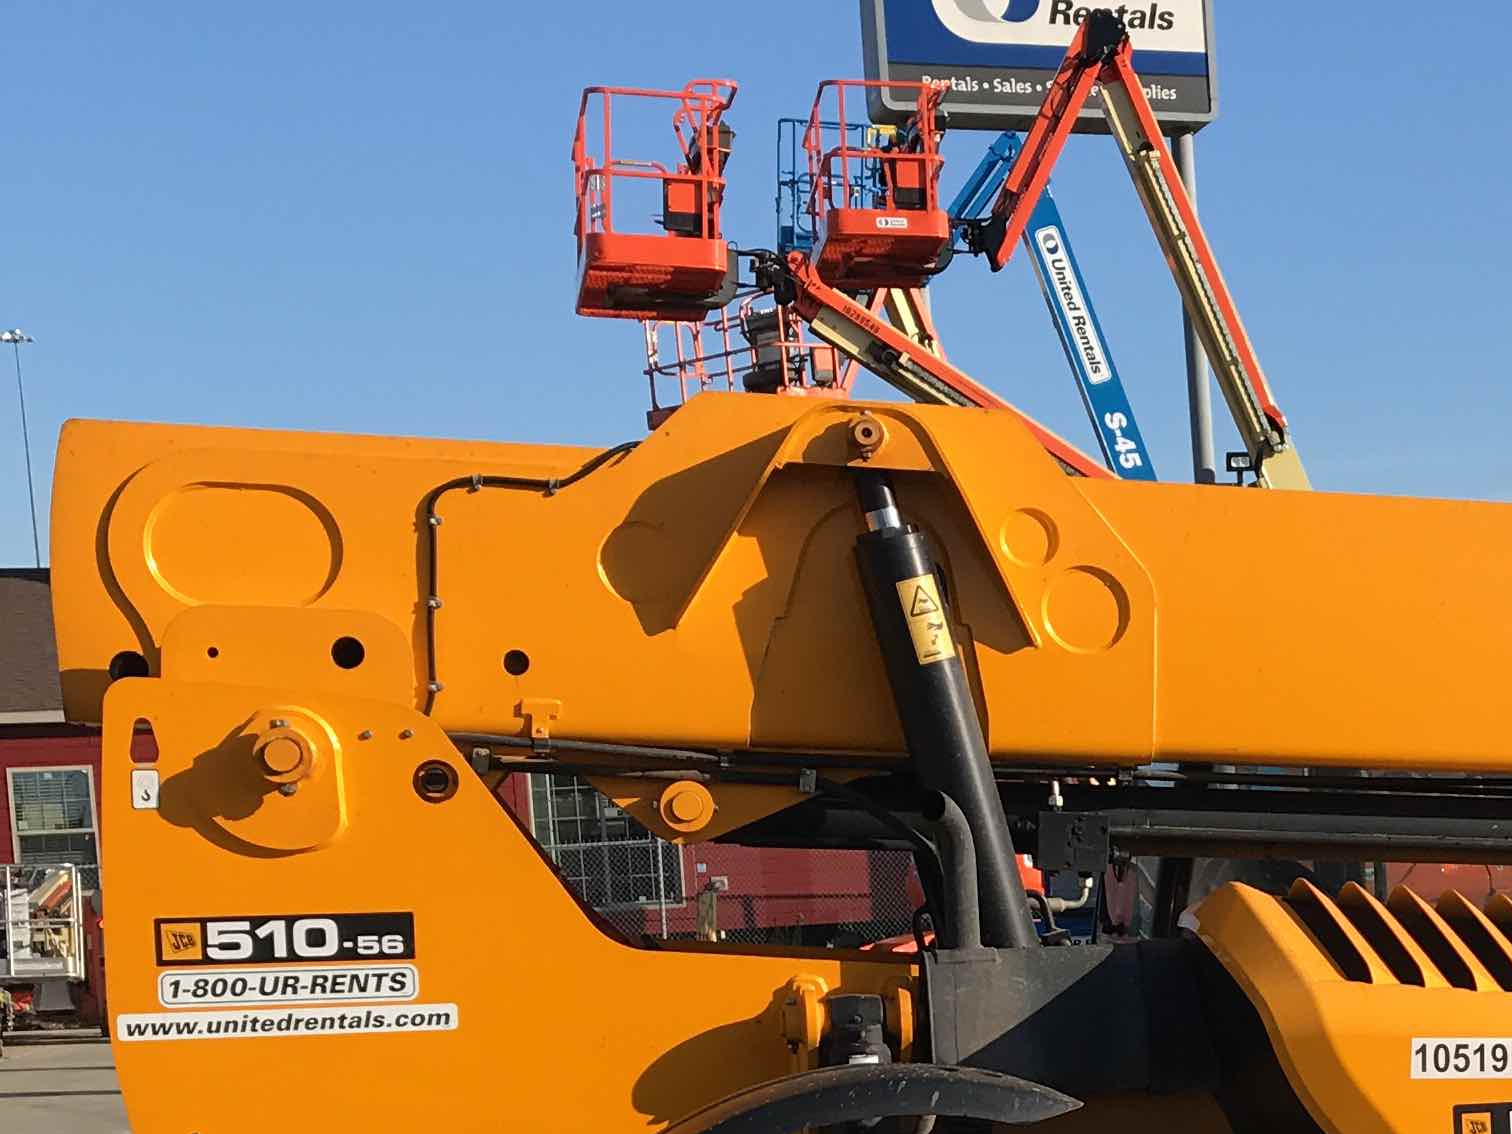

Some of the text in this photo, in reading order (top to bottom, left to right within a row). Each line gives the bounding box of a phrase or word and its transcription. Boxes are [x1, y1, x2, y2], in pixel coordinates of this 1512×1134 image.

[1049, 0, 1175, 30] Retals
[993, 78, 1032, 94] Sales
[1051, 257, 1102, 375] United Rentals
[1104, 411, 1143, 470] S-45
[206, 917, 405, 961] 510-56
[168, 971, 408, 999] 1-800-UR-RENTS
[125, 1010, 451, 1038] www.unitedrentals.com
